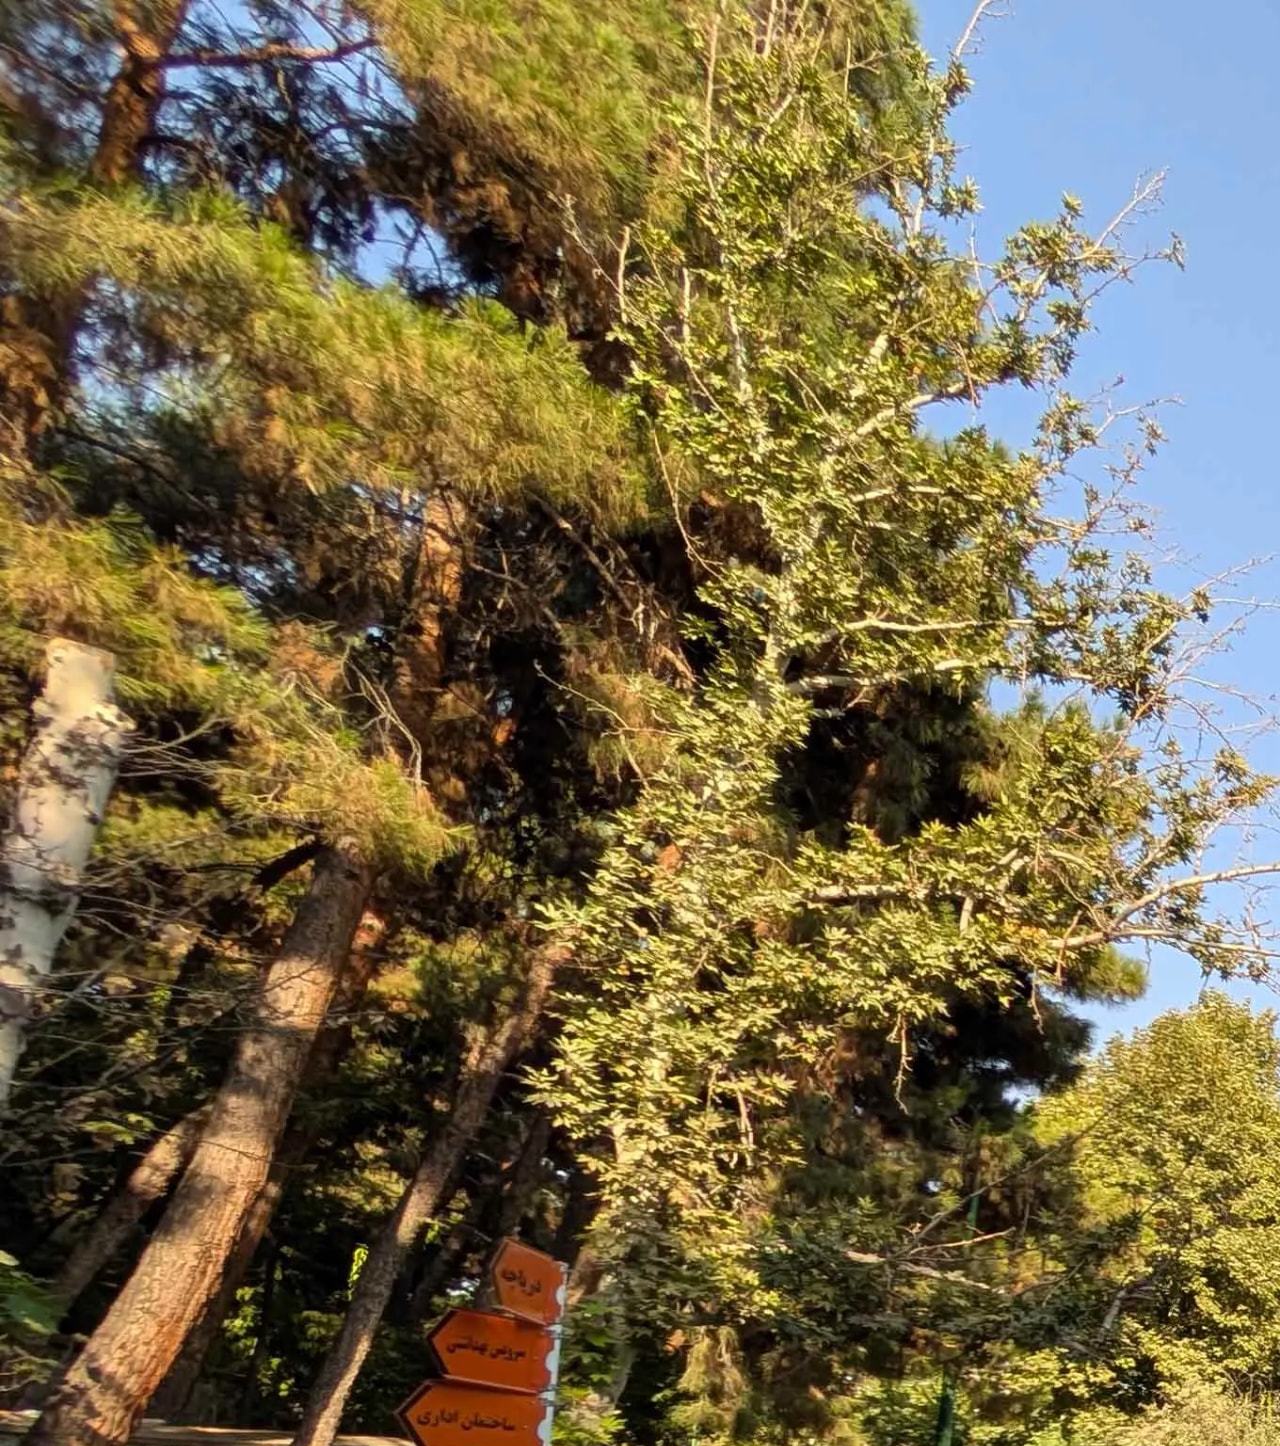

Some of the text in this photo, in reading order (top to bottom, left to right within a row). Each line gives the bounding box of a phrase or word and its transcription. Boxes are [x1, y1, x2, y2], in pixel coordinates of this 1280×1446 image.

[501, 1268, 542, 1298] دریاچه
[417, 1408, 515, 1431] ساختمان اداری
